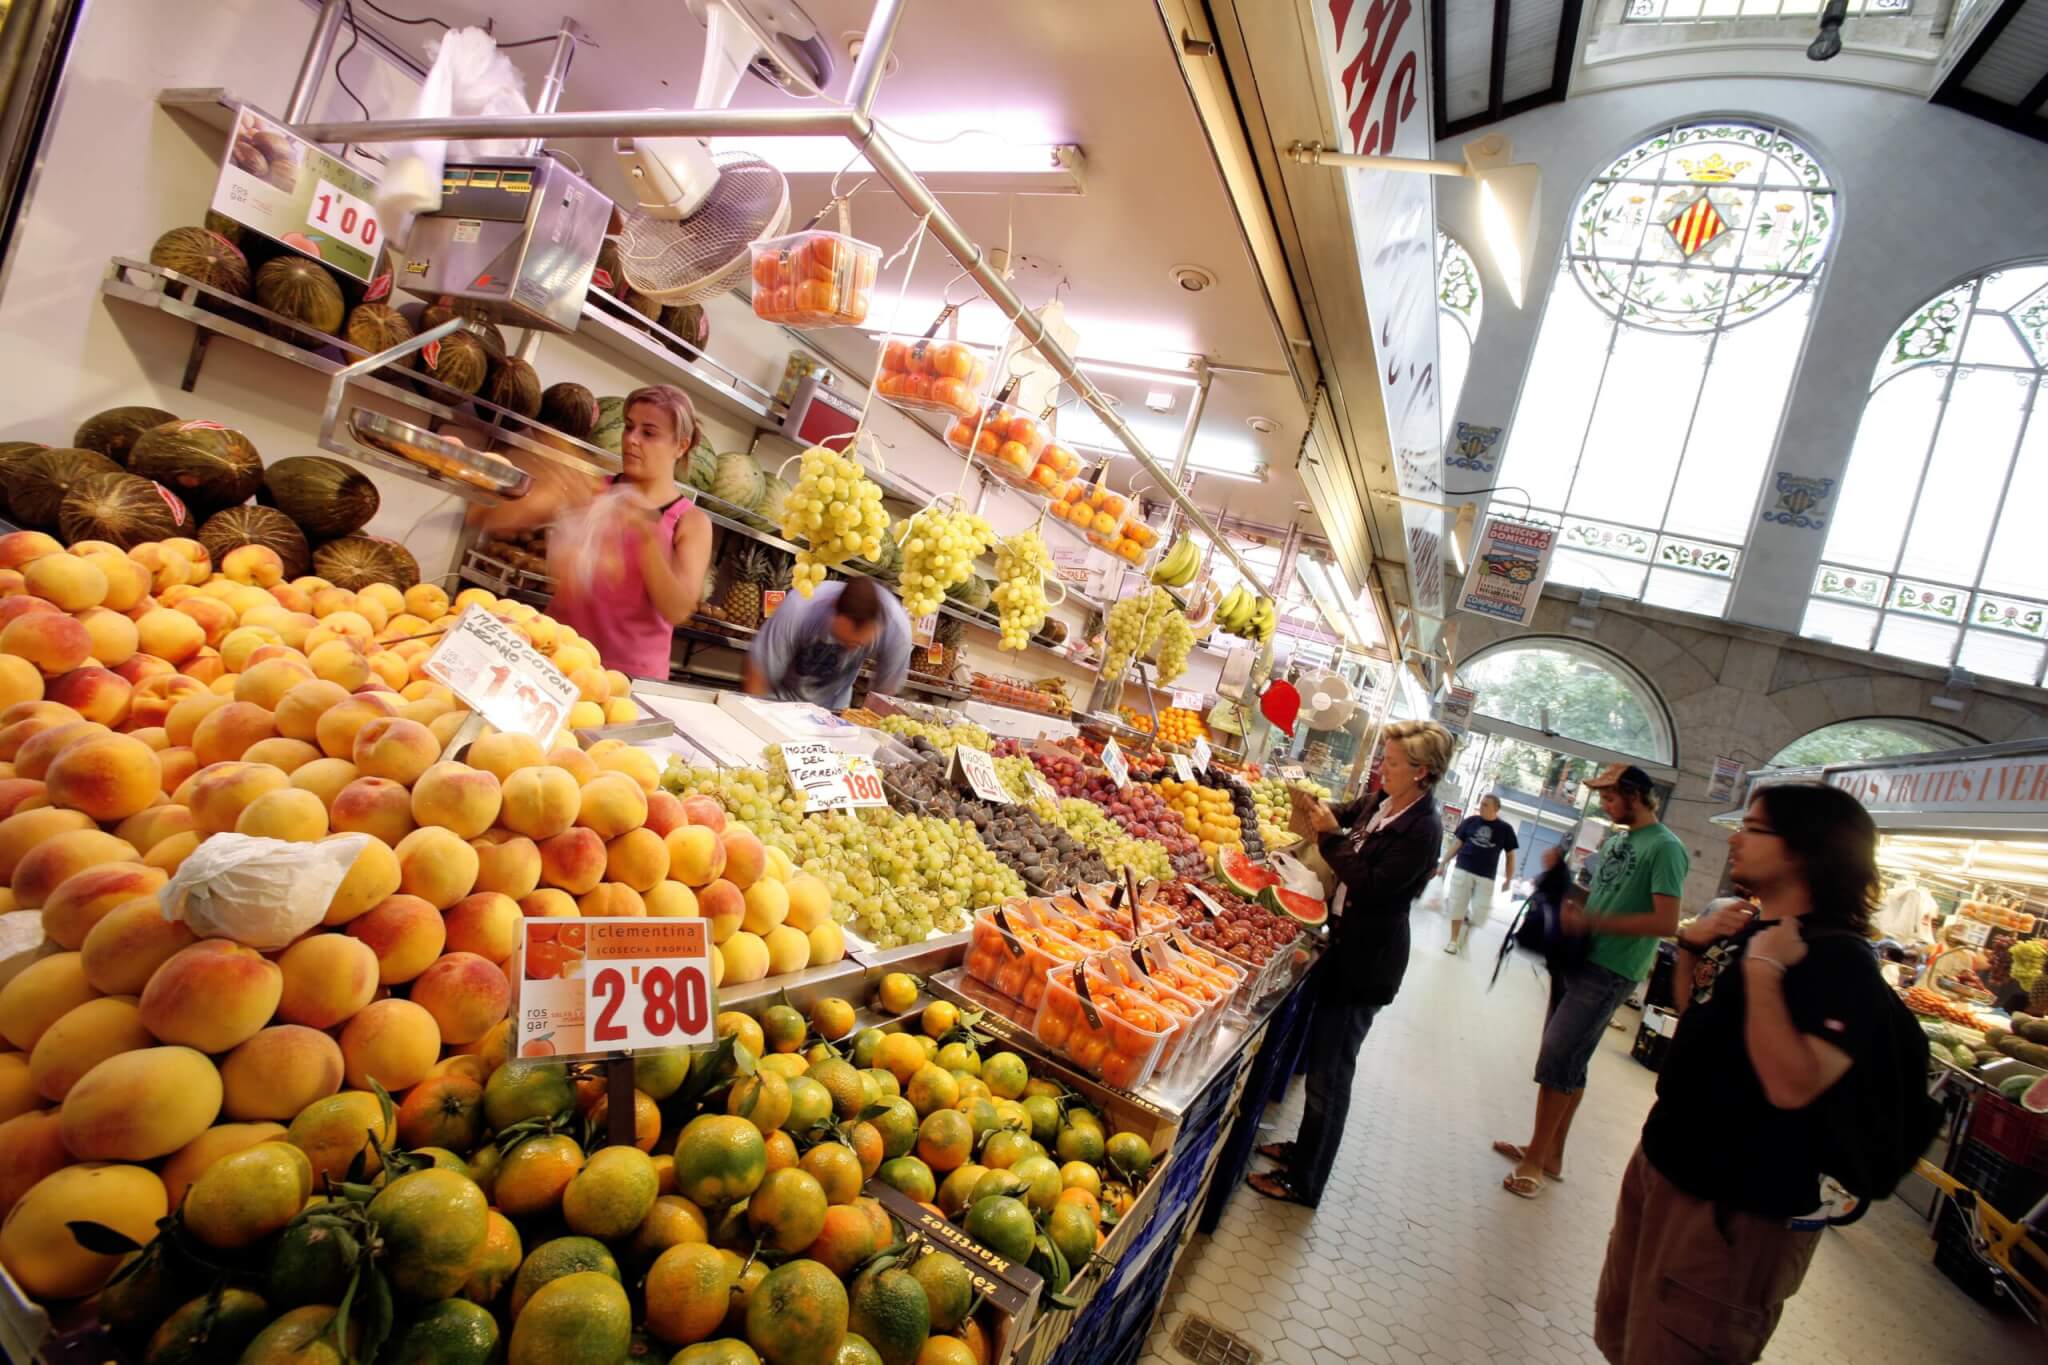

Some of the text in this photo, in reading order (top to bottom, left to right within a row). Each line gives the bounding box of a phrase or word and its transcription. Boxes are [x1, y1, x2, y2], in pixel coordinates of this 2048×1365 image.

[1492, 523, 1538, 538] SERVICIO
[1489, 531, 1548, 549] DOMICILIO
[463, 621, 520, 664] SECANO
[473, 613, 573, 696] MELOCOTON
[785, 744, 836, 755] MOSCATEL
[801, 757, 825, 765] DEL
[959, 751, 985, 766] HIGOS
[791, 767, 843, 781] TERRENO
[1884, 767, 1977, 803] FRUITES
[592, 966, 709, 1042] 2'80
[527, 1007, 548, 1018] ros
[526, 1019, 549, 1033] gar
